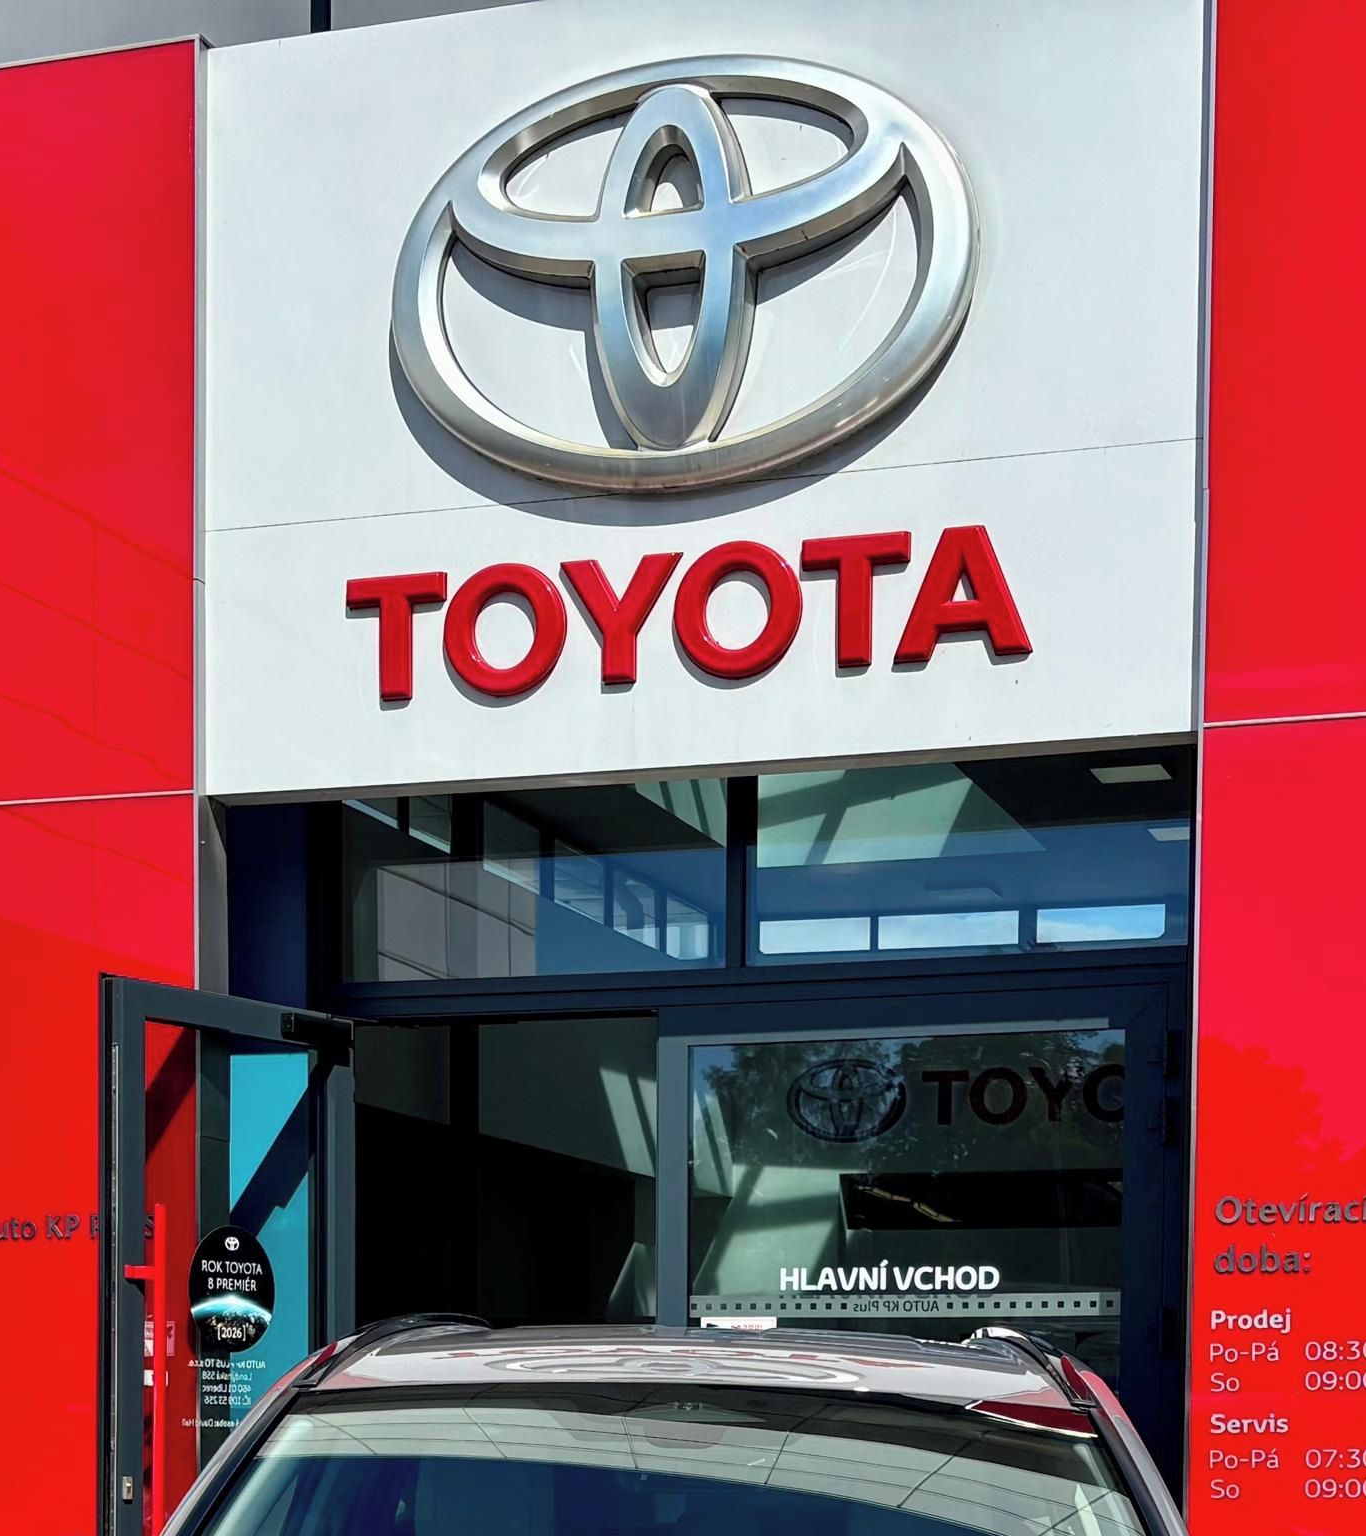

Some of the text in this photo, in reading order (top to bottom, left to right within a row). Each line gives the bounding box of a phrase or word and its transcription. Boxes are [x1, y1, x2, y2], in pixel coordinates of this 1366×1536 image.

[346, 525, 1033, 702] TOYOTA
[922, 1063, 1125, 1126] TOYO
[46, 1214, 81, 1239] KP
[201, 1259, 263, 1275] ROK TOYOTA
[1214, 1244, 1312, 1274] doba:
[207, 1276, 257, 1291] 8 PREMIÉR
[779, 1259, 1001, 1291] HLAVNÍ VCHOD
[1210, 1307, 1292, 1334] Prodej
[217, 1324, 246, 1341] [2026]
[1209, 1340, 1280, 1363] Po-Pá
[1210, 1372, 1240, 1392] So
[1210, 1413, 1289, 1434] Servis
[1209, 1448, 1280, 1469] Po-Pá
[1210, 1479, 1240, 1498] So
